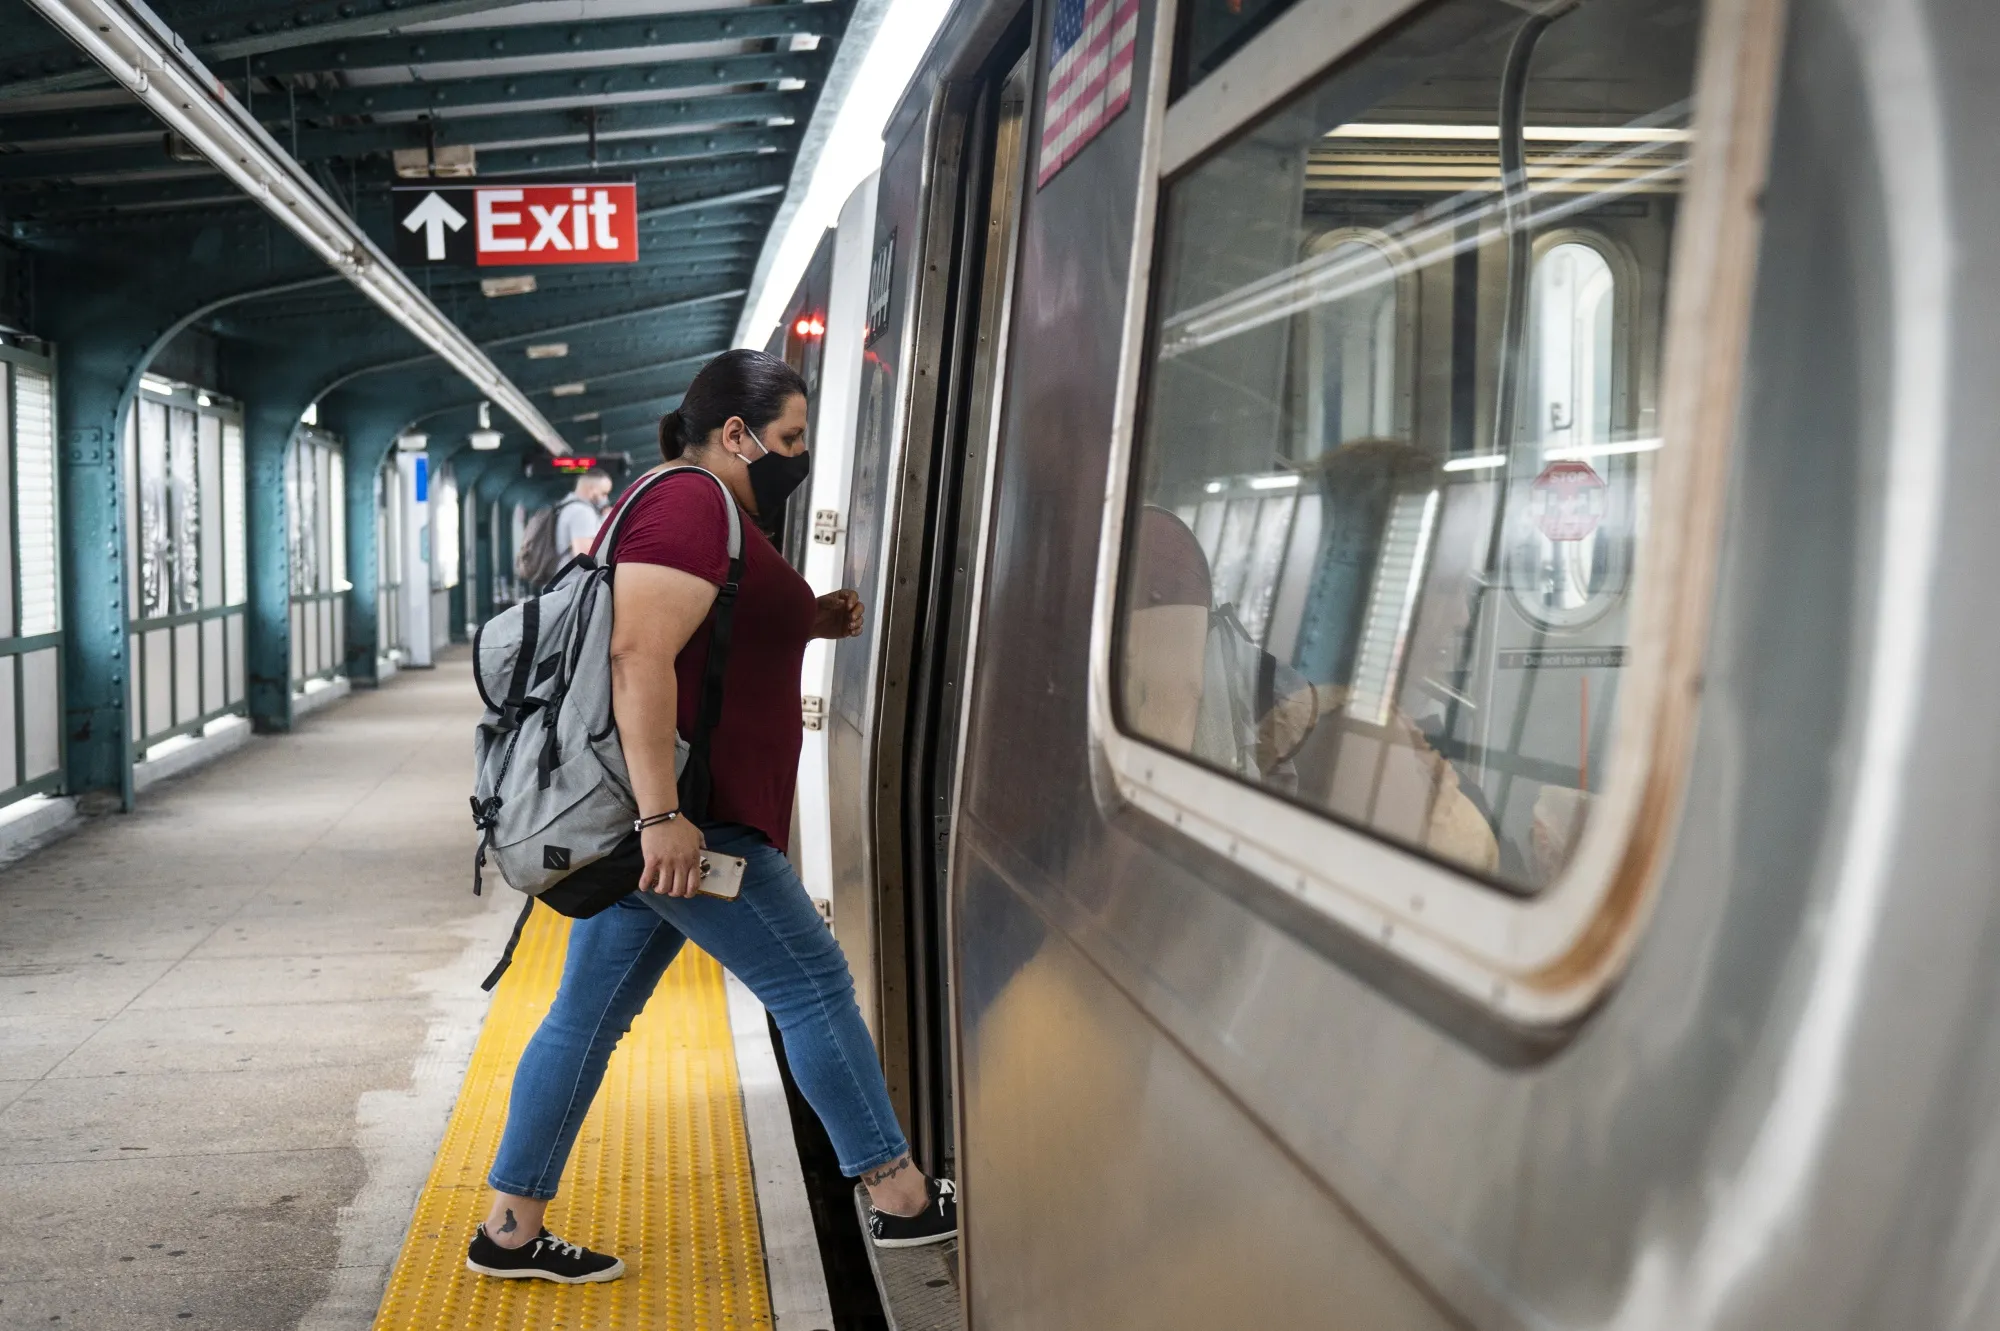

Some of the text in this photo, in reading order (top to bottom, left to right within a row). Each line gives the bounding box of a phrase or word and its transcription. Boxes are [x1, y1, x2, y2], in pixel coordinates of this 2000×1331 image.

[476, 187, 619, 253] Exit
[1549, 471, 1589, 483] STOP
[1523, 654, 1540, 666] Do
[1541, 654, 1560, 666] not
[1562, 654, 1586, 666] lean
[1587, 655, 1602, 666] on
